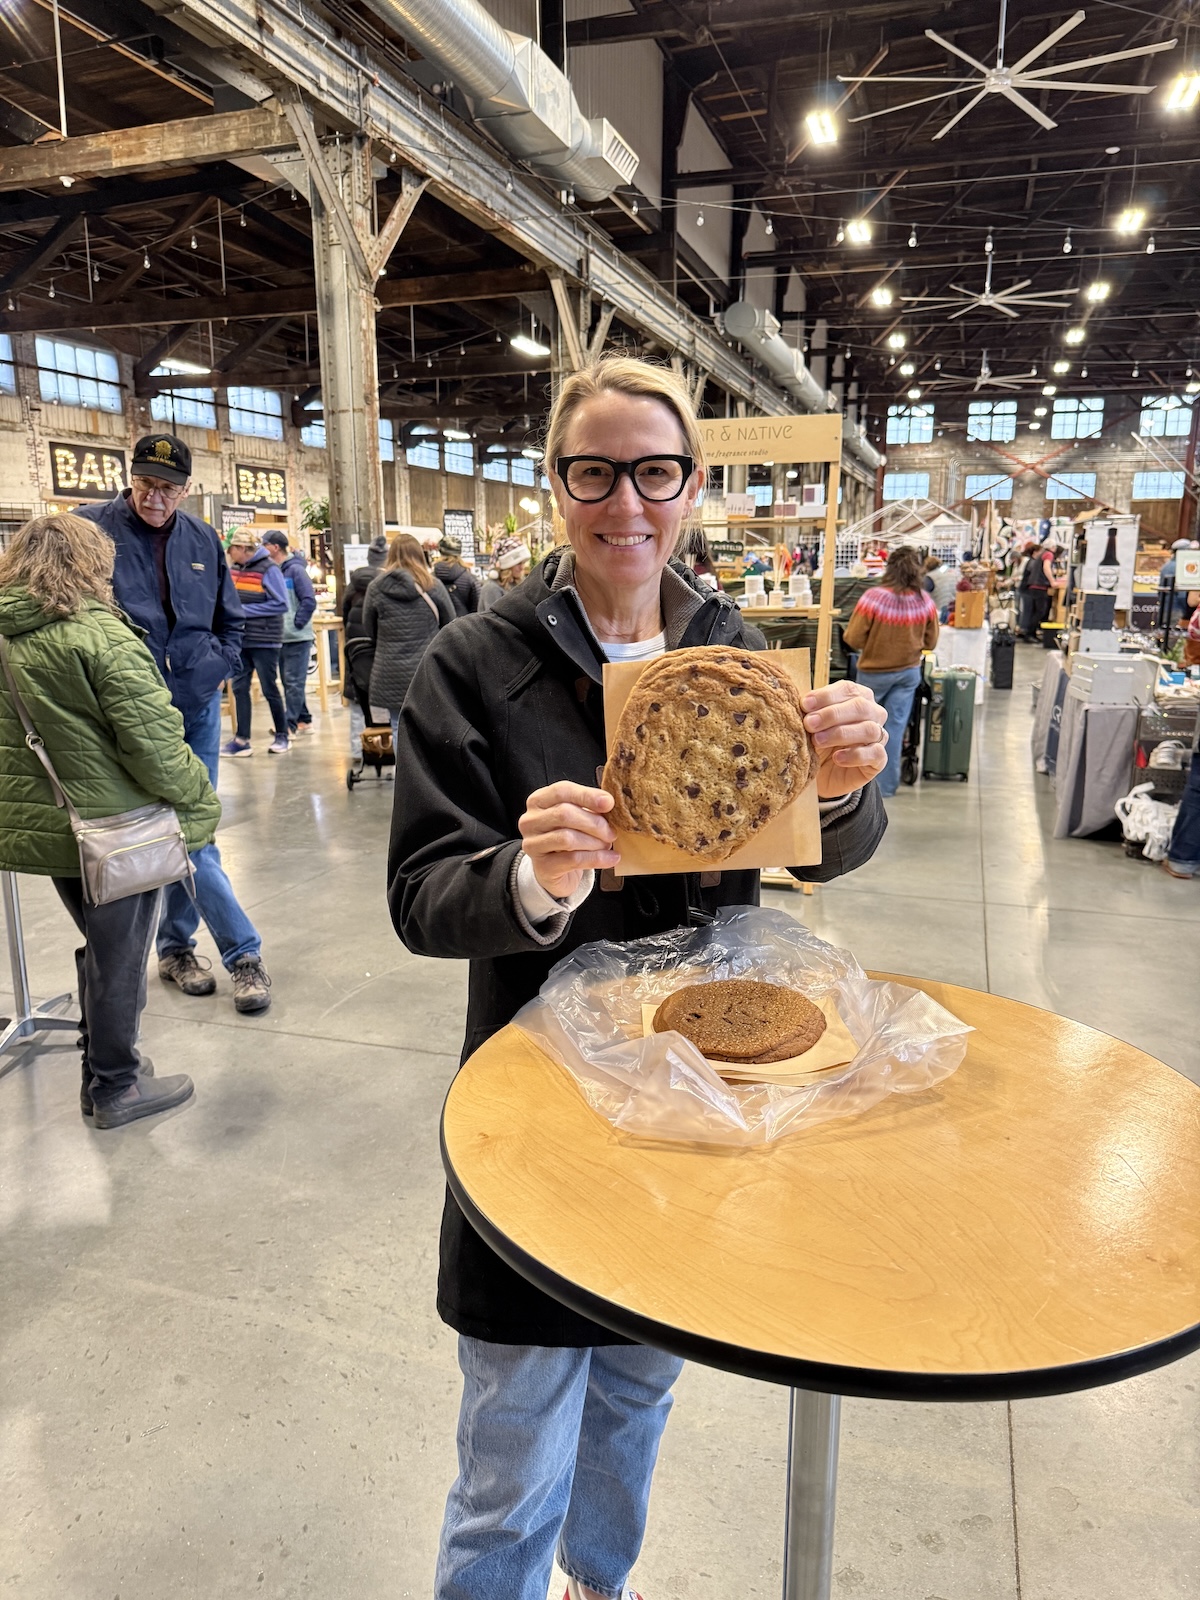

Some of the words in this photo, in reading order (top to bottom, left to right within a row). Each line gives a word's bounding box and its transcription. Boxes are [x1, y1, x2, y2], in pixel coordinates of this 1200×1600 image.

[720, 425, 731, 441] &
[737, 425, 793, 441] NATIVE
[714, 450, 747, 459] fragrance
[748, 449, 769, 457] studio
[54, 448, 125, 492] BAR
[238, 469, 286, 505] BAR
